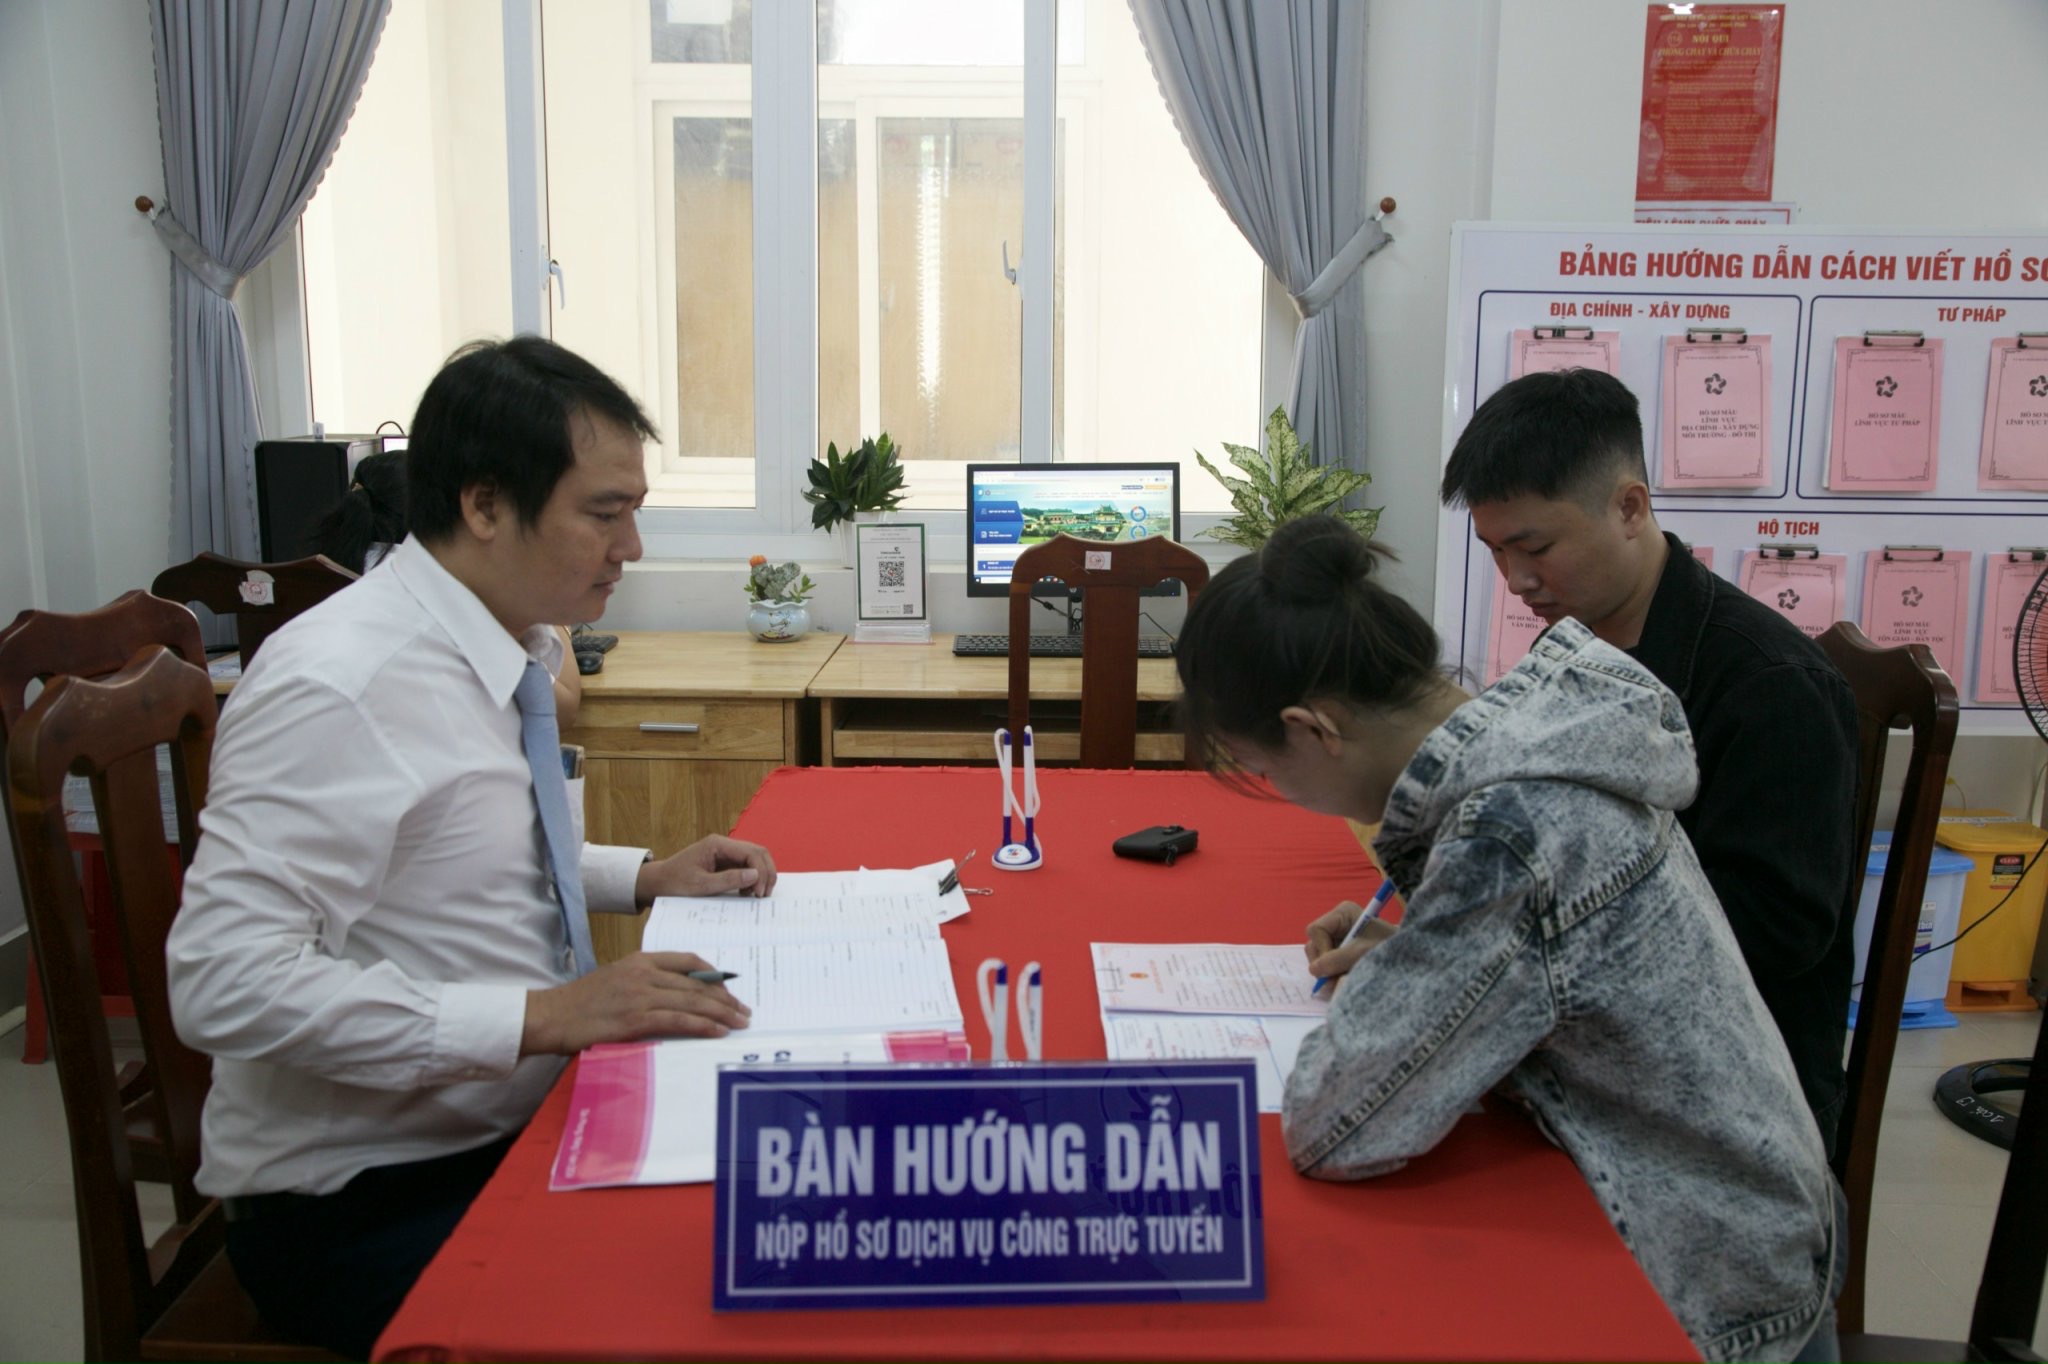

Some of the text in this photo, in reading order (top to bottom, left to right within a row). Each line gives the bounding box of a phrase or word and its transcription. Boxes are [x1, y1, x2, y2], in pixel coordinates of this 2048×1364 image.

[1559, 243, 1637, 277] BẢNG
[1646, 248, 1743, 279] HƯỚNG
[1752, 245, 1812, 279] DẪN
[1820, 250, 1897, 280] CÁCH
[1906, 248, 1966, 281] VIẾT
[1973, 248, 2012, 282] HỒ
[1550, 302, 1577, 319] ĐỊA
[1583, 300, 1633, 317] CHÍNH
[1649, 301, 1681, 318] XÂY
[1686, 303, 1730, 321] DỰNG
[1938, 305, 2006, 322] TƯ PHÁP
[1758, 518, 1819, 538] HỘ TỊCH
[756, 1094, 1221, 1197] BÀN HƯỚNG DẪN
[755, 1213, 808, 1269] NỘP
[855, 1217, 891, 1261] SƠ
[896, 1217, 956, 1267] DỊCH
[961, 1216, 995, 1266] VỤ
[1002, 1209, 1069, 1258] CÔNG
[1075, 1216, 1139, 1264] TRỰC
[1145, 1203, 1223, 1256] TUYẾN
